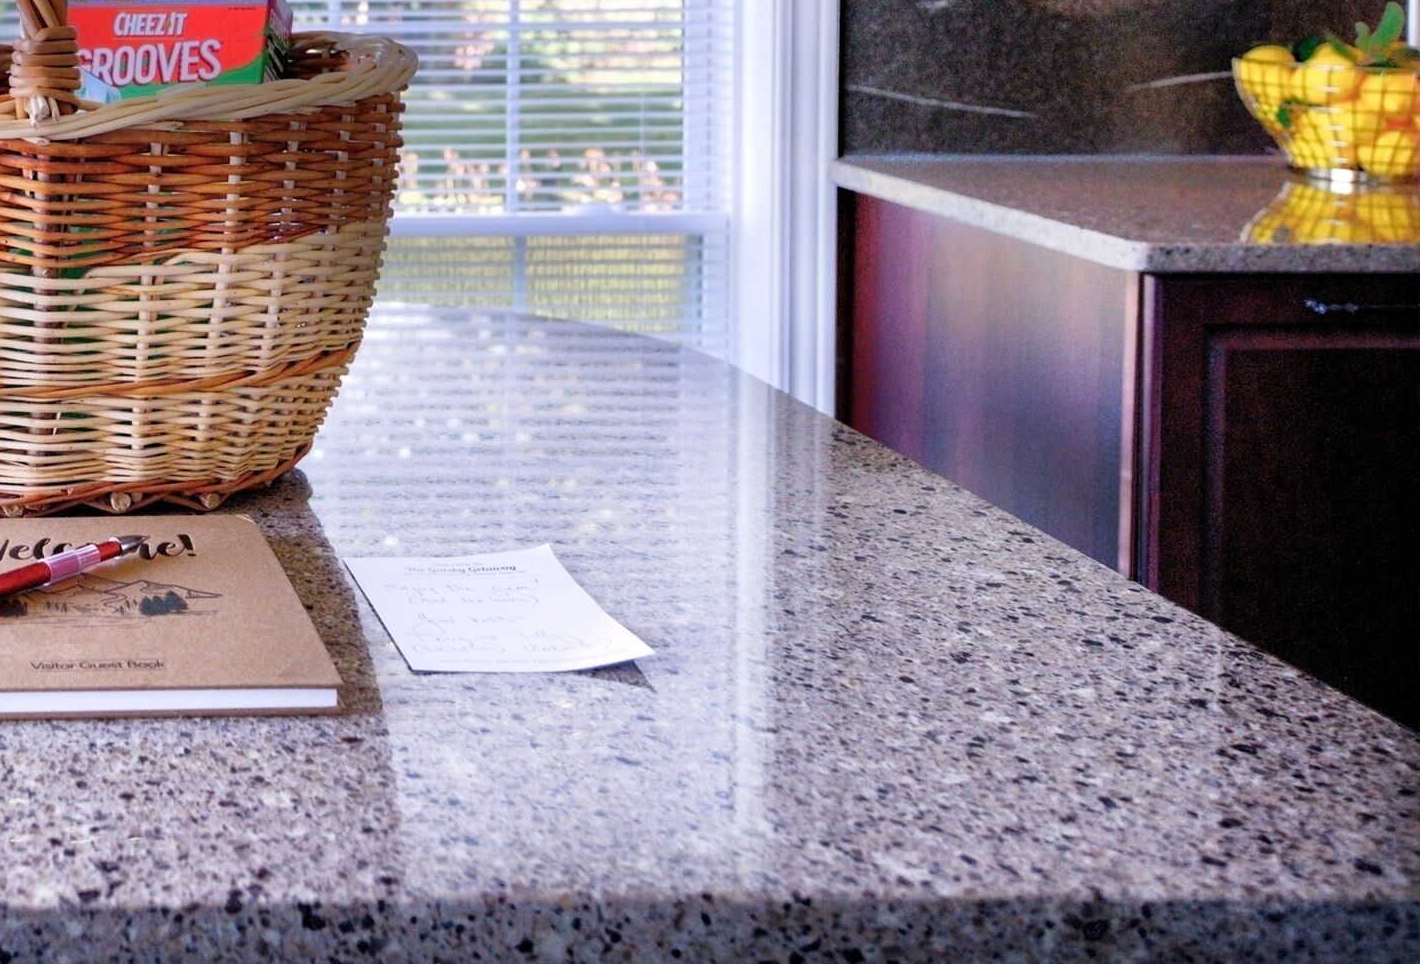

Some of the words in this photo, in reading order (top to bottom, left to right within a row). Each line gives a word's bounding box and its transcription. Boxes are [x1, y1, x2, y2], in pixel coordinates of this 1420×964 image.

[30, 661, 76, 670] Visitor
[79, 660, 123, 670] Guest
[127, 659, 165, 669] Book
